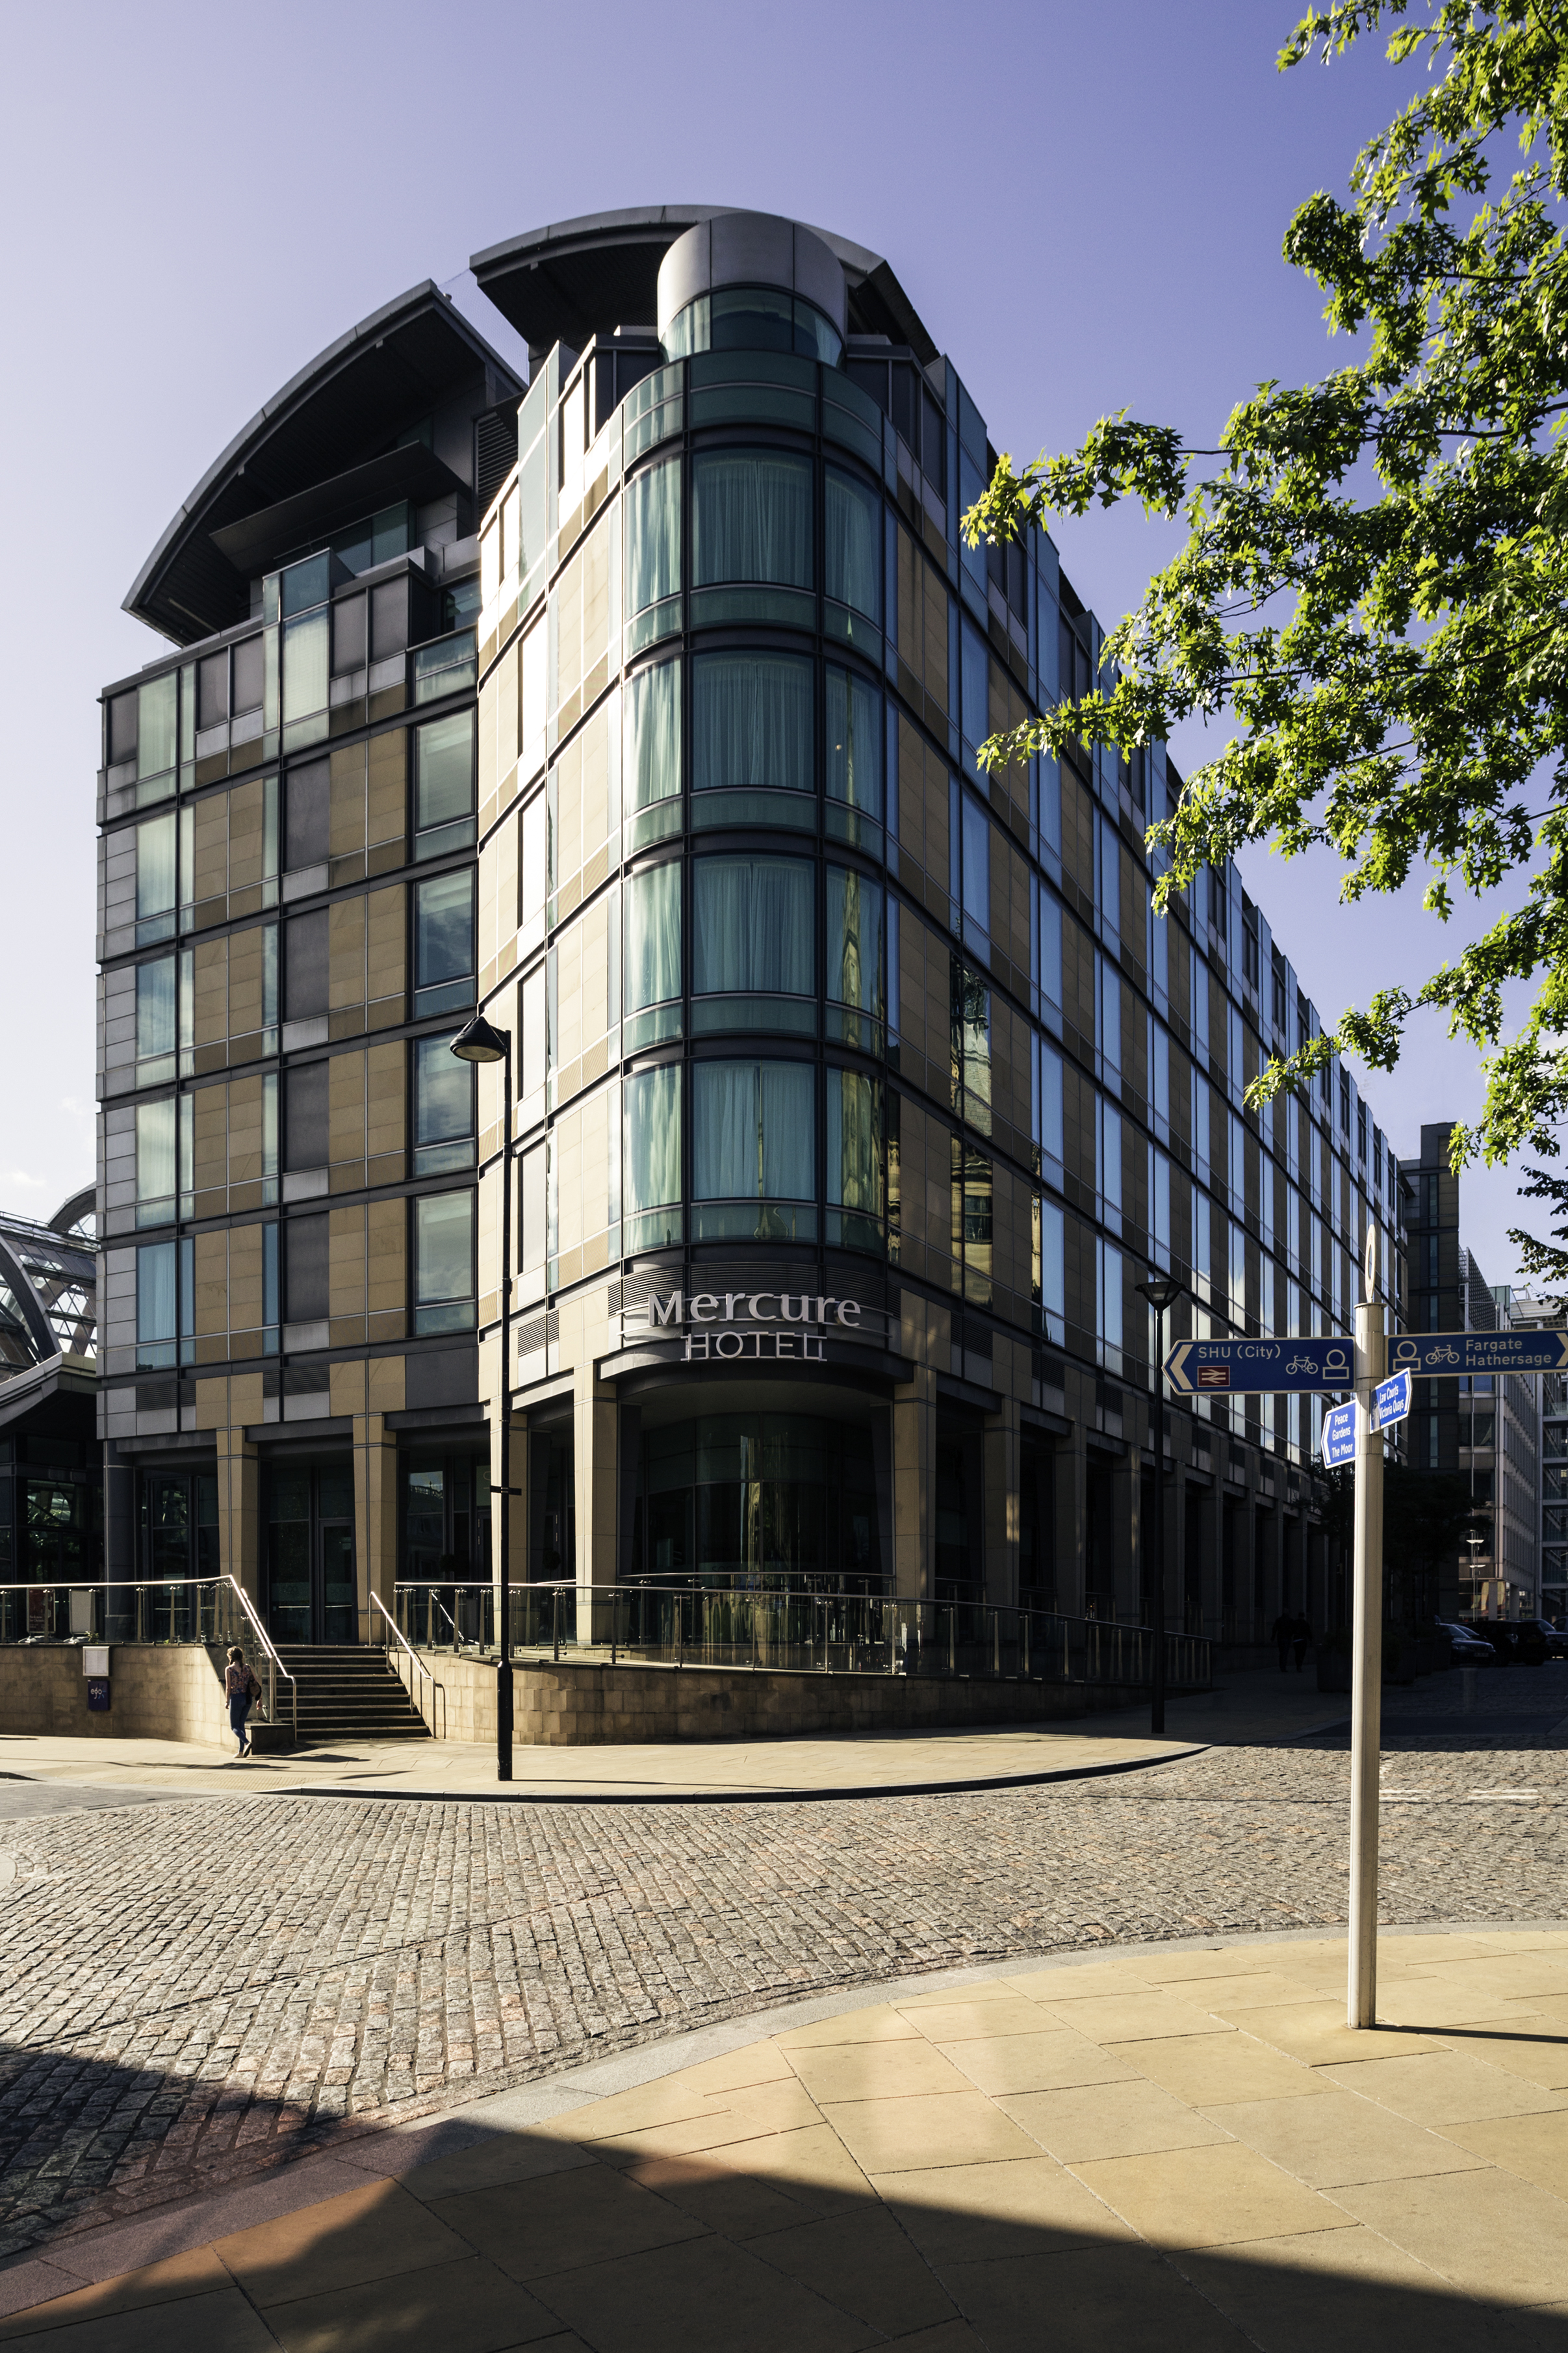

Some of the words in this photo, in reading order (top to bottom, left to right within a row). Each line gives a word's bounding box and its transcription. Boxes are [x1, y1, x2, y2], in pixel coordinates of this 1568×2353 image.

[649, 1290, 861, 1327] Mercure
[687, 1331, 821, 1360] HOTEL
[1198, 1347, 1231, 1358] SHU
[1237, 1344, 1281, 1359] (City)
[1466, 1338, 1523, 1353] Fargate
[1466, 1354, 1552, 1366] Hathersage
[1387, 1384, 1399, 1400] Courts
[1379, 1404, 1393, 1420] Victoria
[1393, 1399, 1404, 1414] Quays
[1335, 1413, 1348, 1426] Peace
[1332, 1427, 1351, 1441] Gardens
[1331, 1446, 1340, 1458] The
[1341, 1443, 1354, 1455] Moor
[90, 1687, 103, 1700] ego
